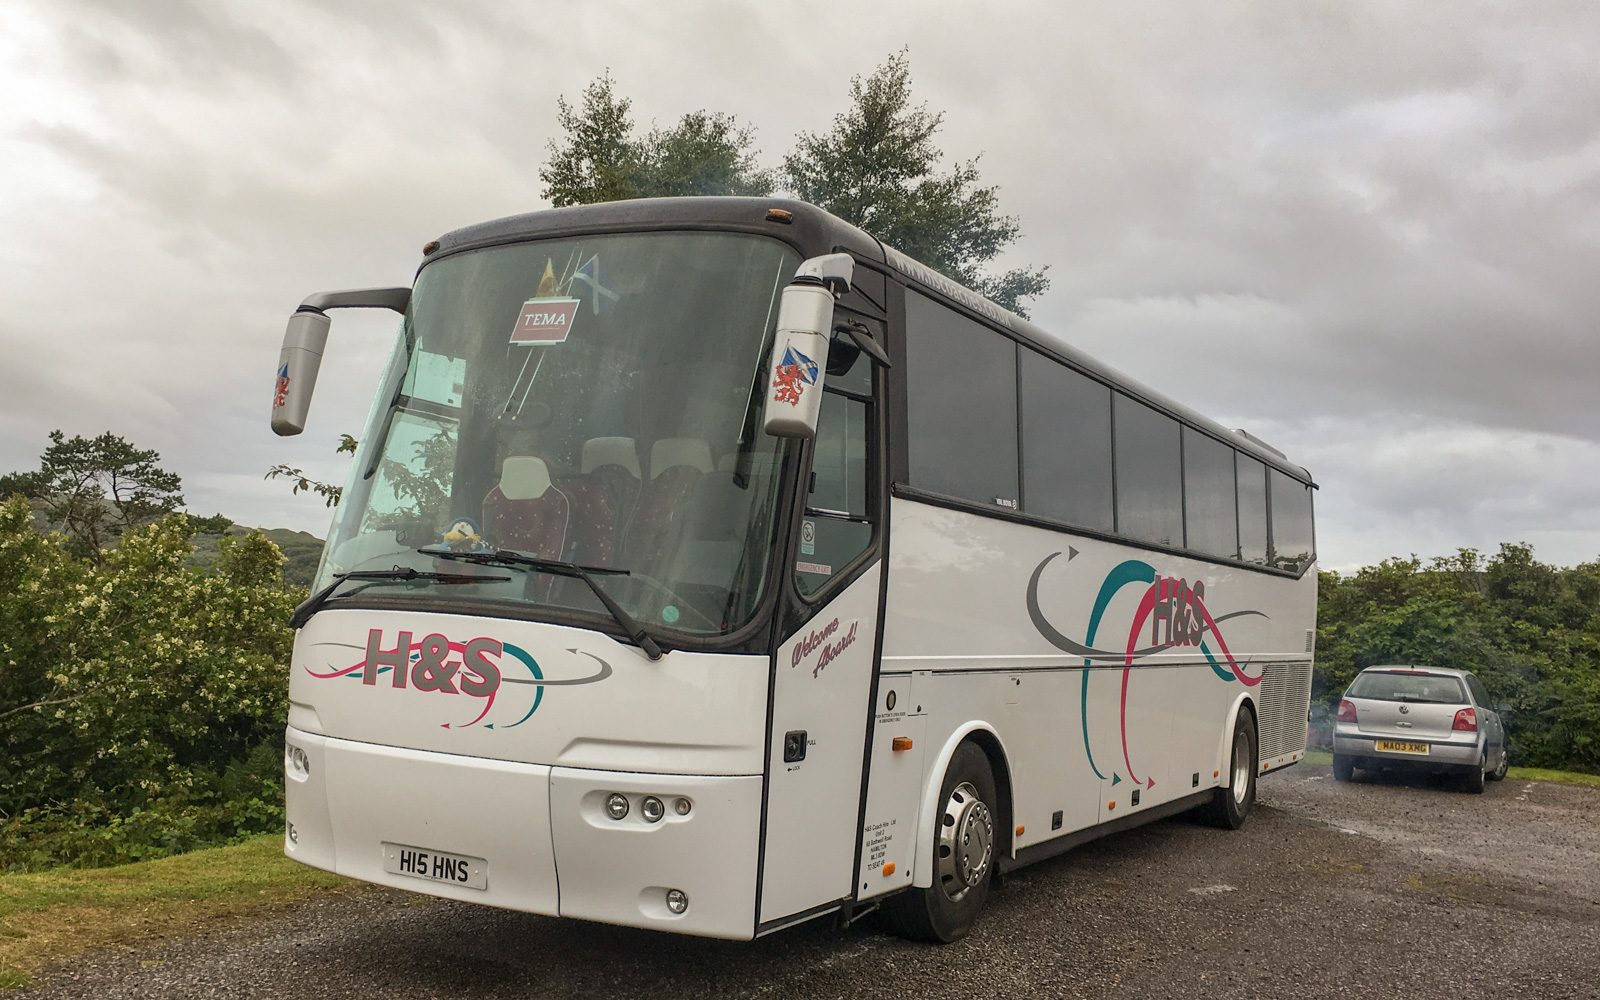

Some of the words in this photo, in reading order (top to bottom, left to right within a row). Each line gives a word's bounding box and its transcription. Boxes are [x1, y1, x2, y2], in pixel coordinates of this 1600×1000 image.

[524, 313, 566, 326] TEMA
[1152, 574, 1205, 647] H&S
[362, 628, 503, 697] H&S
[791, 617, 840, 669] Welcome
[812, 620, 858, 679] Aboard!
[1383, 741, 1407, 751] MA03
[400, 850, 429, 875] H15
[433, 856, 468, 882] HNS
